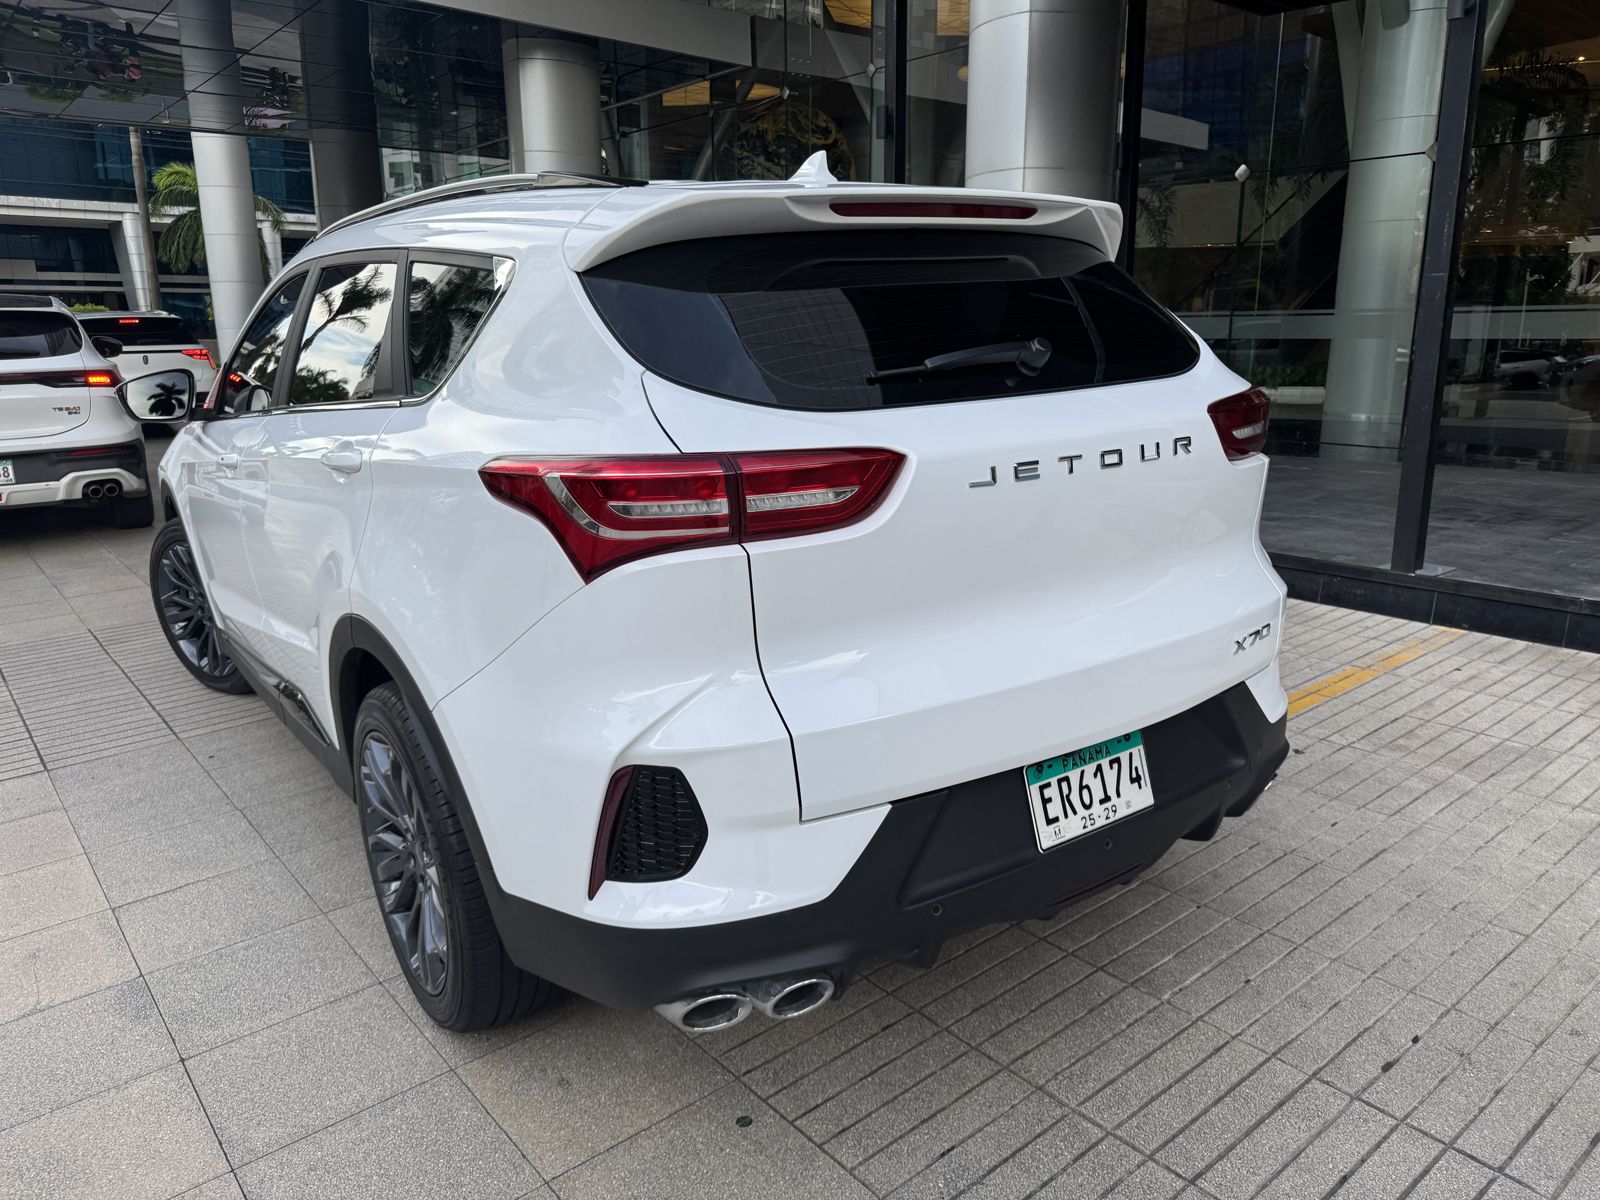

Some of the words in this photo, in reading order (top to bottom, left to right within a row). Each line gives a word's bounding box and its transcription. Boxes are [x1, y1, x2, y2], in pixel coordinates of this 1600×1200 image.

[968, 436, 1192, 488] JETOUR
[1232, 622, 1271, 656] X70
[1061, 744, 1112, 773] PANAMA
[1038, 751, 1142, 827] ER6174
